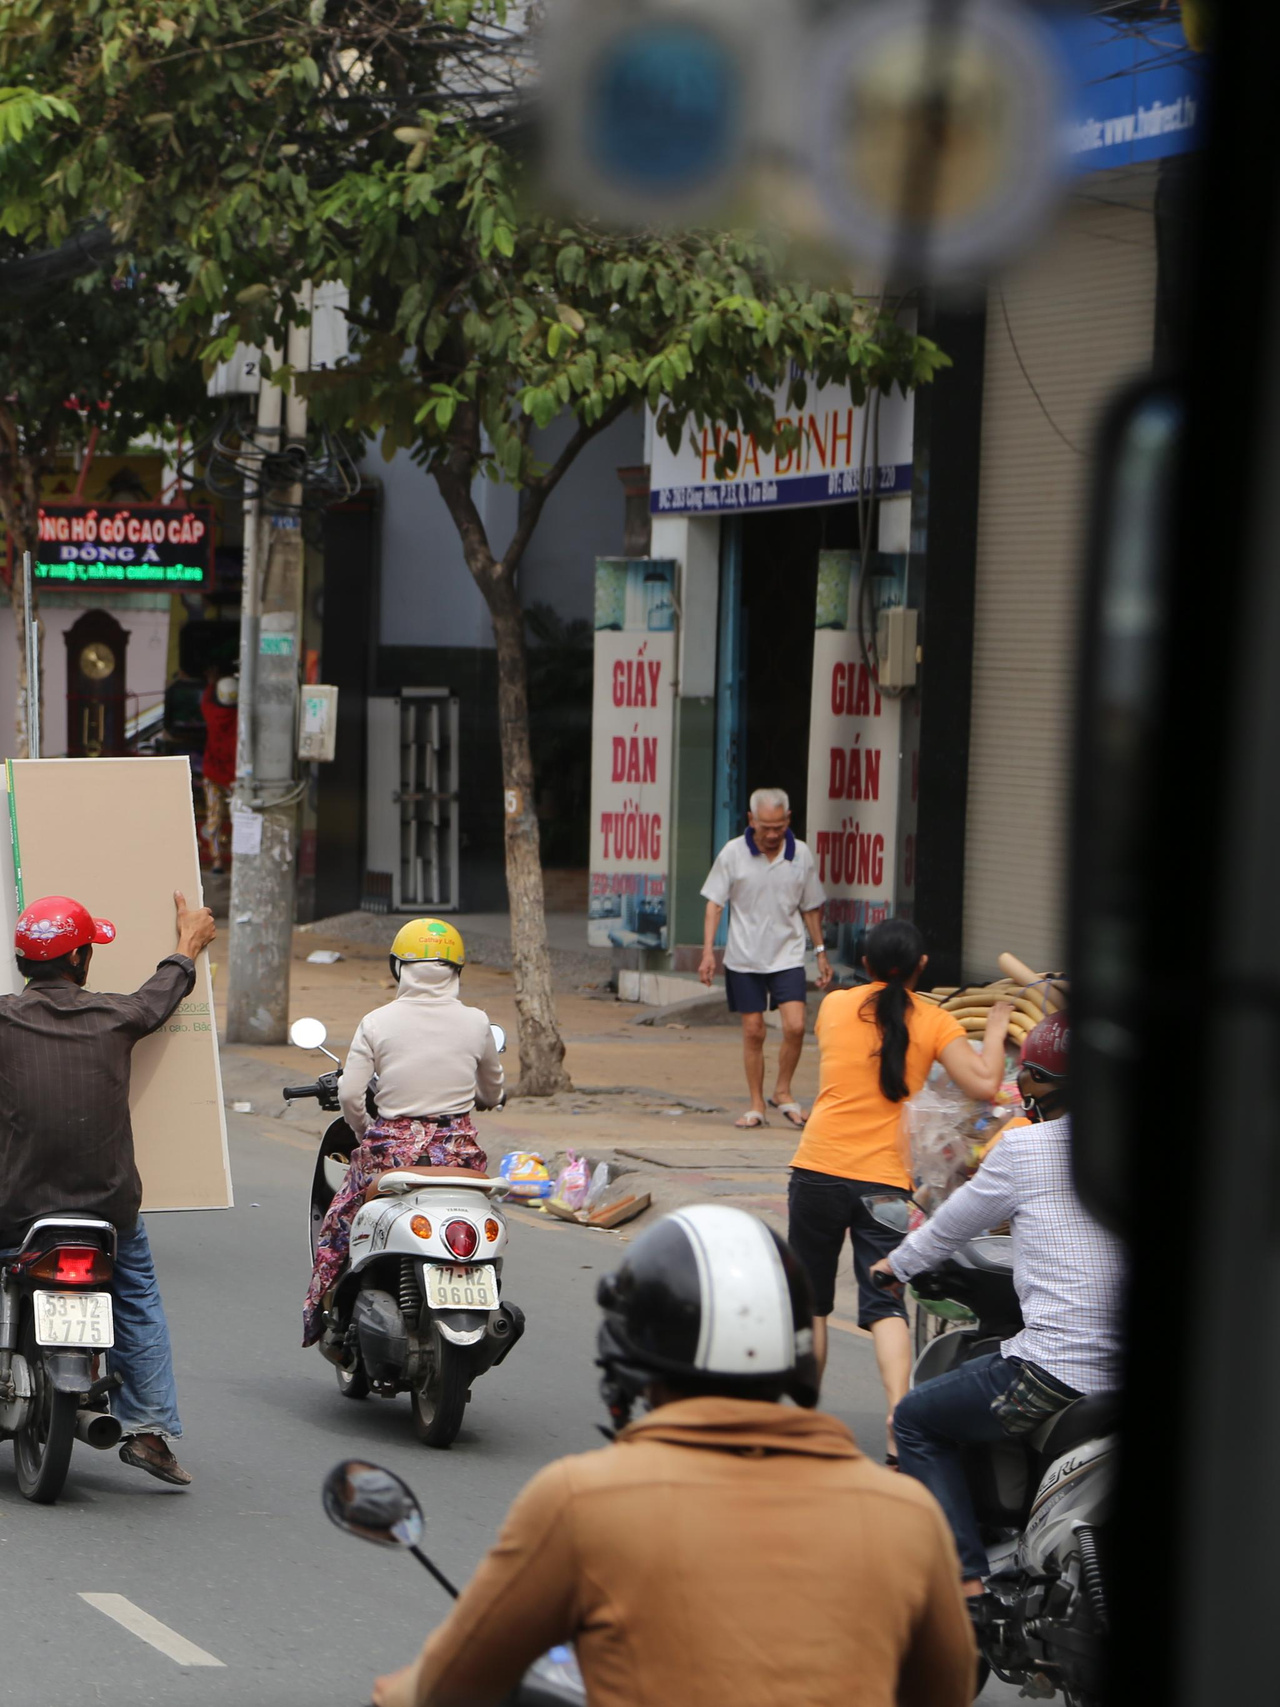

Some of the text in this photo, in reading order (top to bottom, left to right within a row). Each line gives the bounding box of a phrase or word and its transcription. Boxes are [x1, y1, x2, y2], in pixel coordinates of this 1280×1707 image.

[127, 519, 166, 543] CAO
[612, 640, 662, 708] GIẤY
[611, 722, 658, 783] DÁN
[828, 733, 881, 801] DÁN
[600, 798, 662, 861] TƯỜNG
[817, 816, 884, 887] TƯỜNG
[435, 1267, 487, 1287] 77-N2
[437, 1286, 488, 1306] 9609
[46, 1295, 101, 1319] 53-V2
[47, 1319, 102, 1343] 4775
